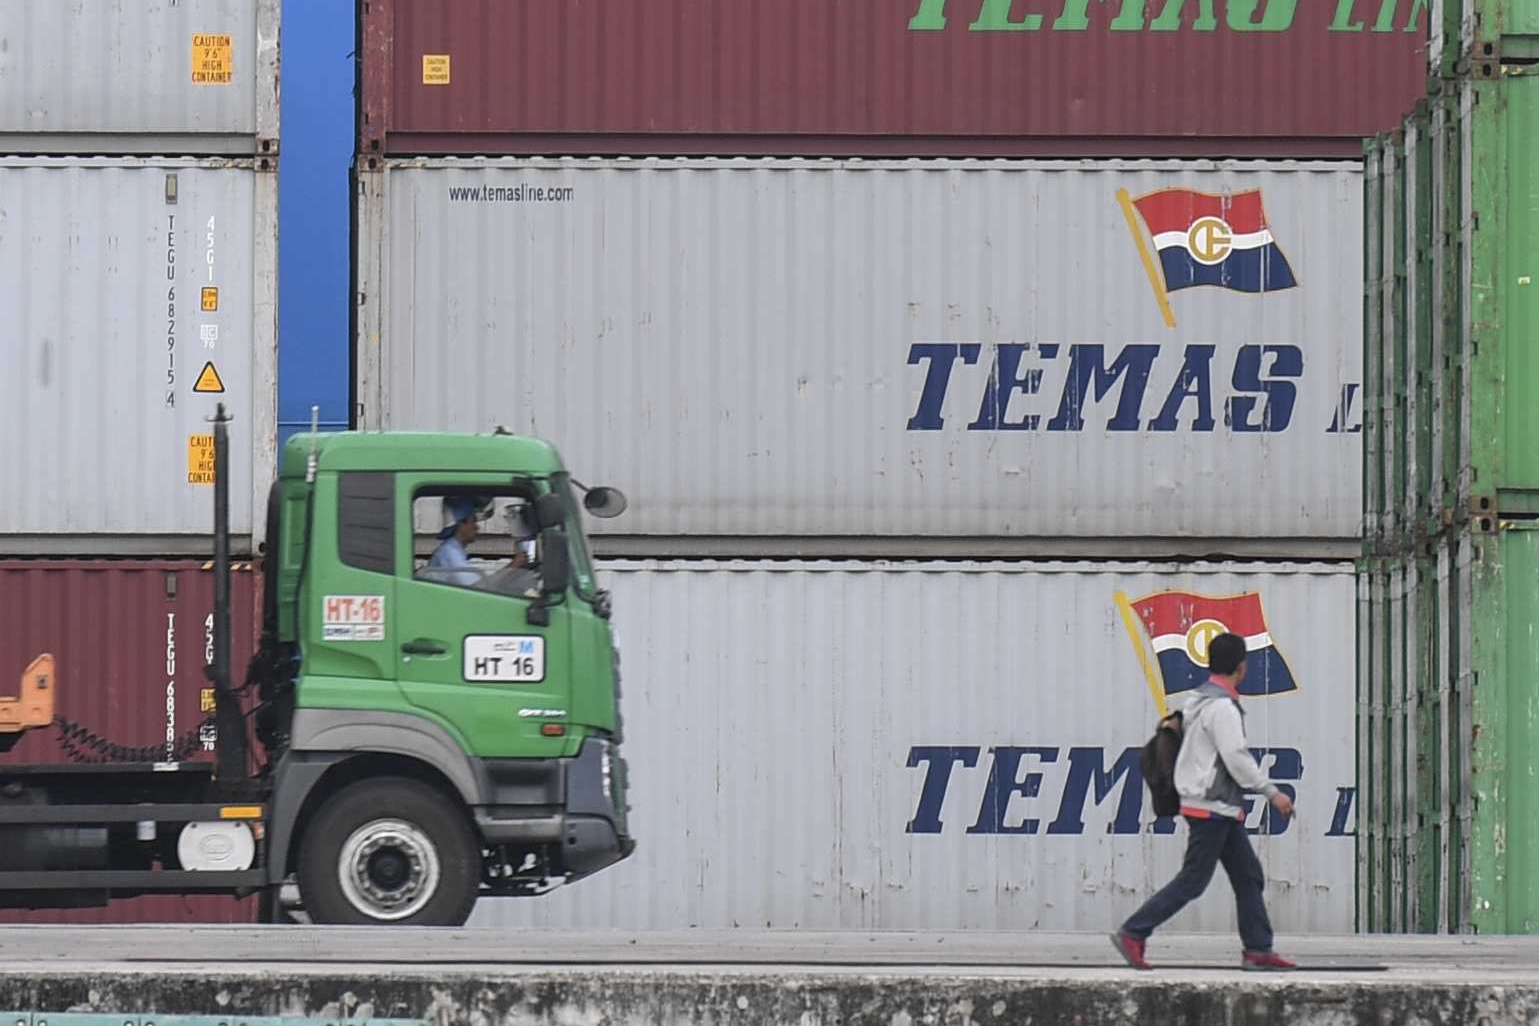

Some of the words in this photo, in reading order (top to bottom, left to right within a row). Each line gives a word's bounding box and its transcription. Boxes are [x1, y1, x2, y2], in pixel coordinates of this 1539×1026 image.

[194, 36, 230, 47] CAUTION
[202, 60, 222, 71] HIGH
[192, 72, 232, 83] CONTAINER
[449, 183, 574, 202] www.temasline.com
[167, 215, 175, 280] TEGU
[206, 215, 215, 281] 45G1
[203, 340, 215, 349] 70
[907, 343, 1304, 432] TEMAS
[167, 391, 175, 407] 4
[327, 598, 380, 622] HT-16
[167, 613, 175, 676] TEGU
[205, 613, 214, 665] 45G
[474, 657, 502, 676] HT
[512, 657, 534, 676] 16
[203, 742, 215, 751] 70
[905, 746, 1304, 836] TEMS
